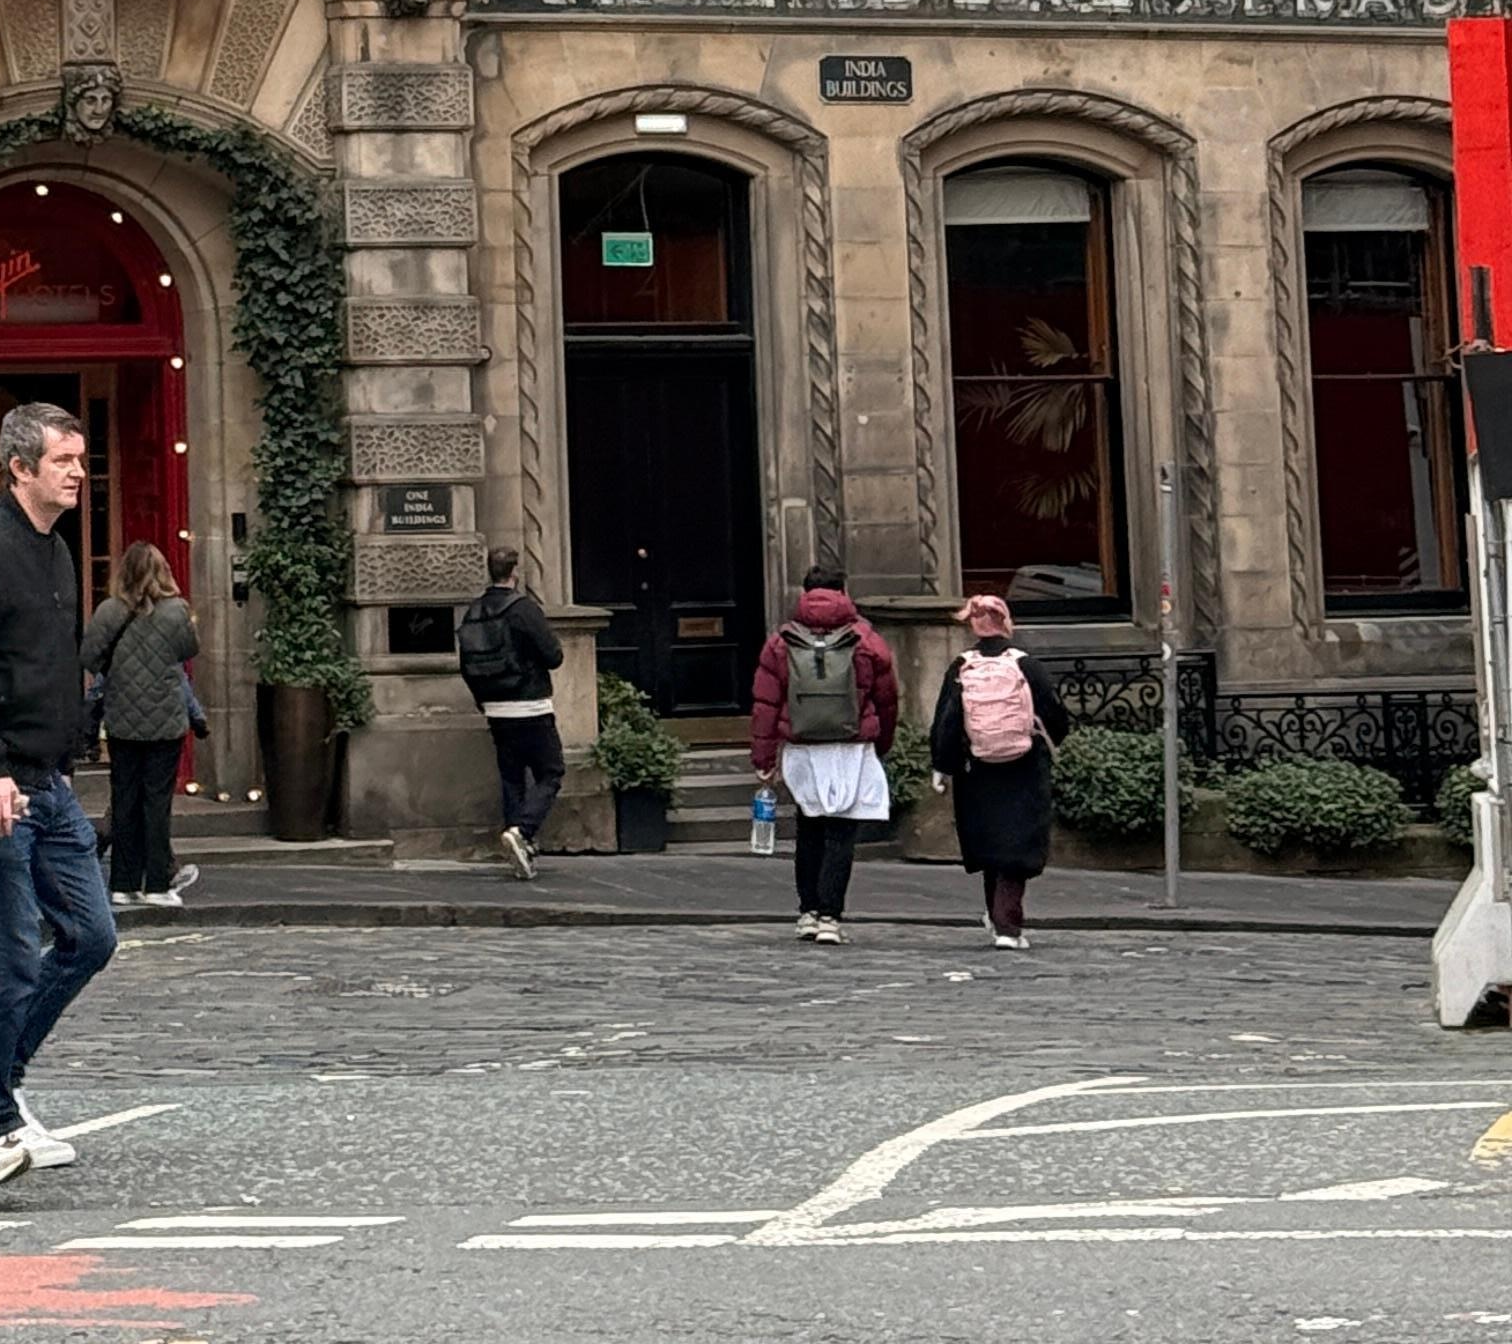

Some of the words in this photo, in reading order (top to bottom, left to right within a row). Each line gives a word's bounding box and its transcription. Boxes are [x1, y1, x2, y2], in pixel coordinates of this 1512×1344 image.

[845, 60, 886, 78] INDIA
[826, 80, 907, 98] BUILDINGS
[406, 491, 428, 501] ONE
[404, 503, 433, 512] INDIA
[391, 515, 446, 525] BUILDINGS
